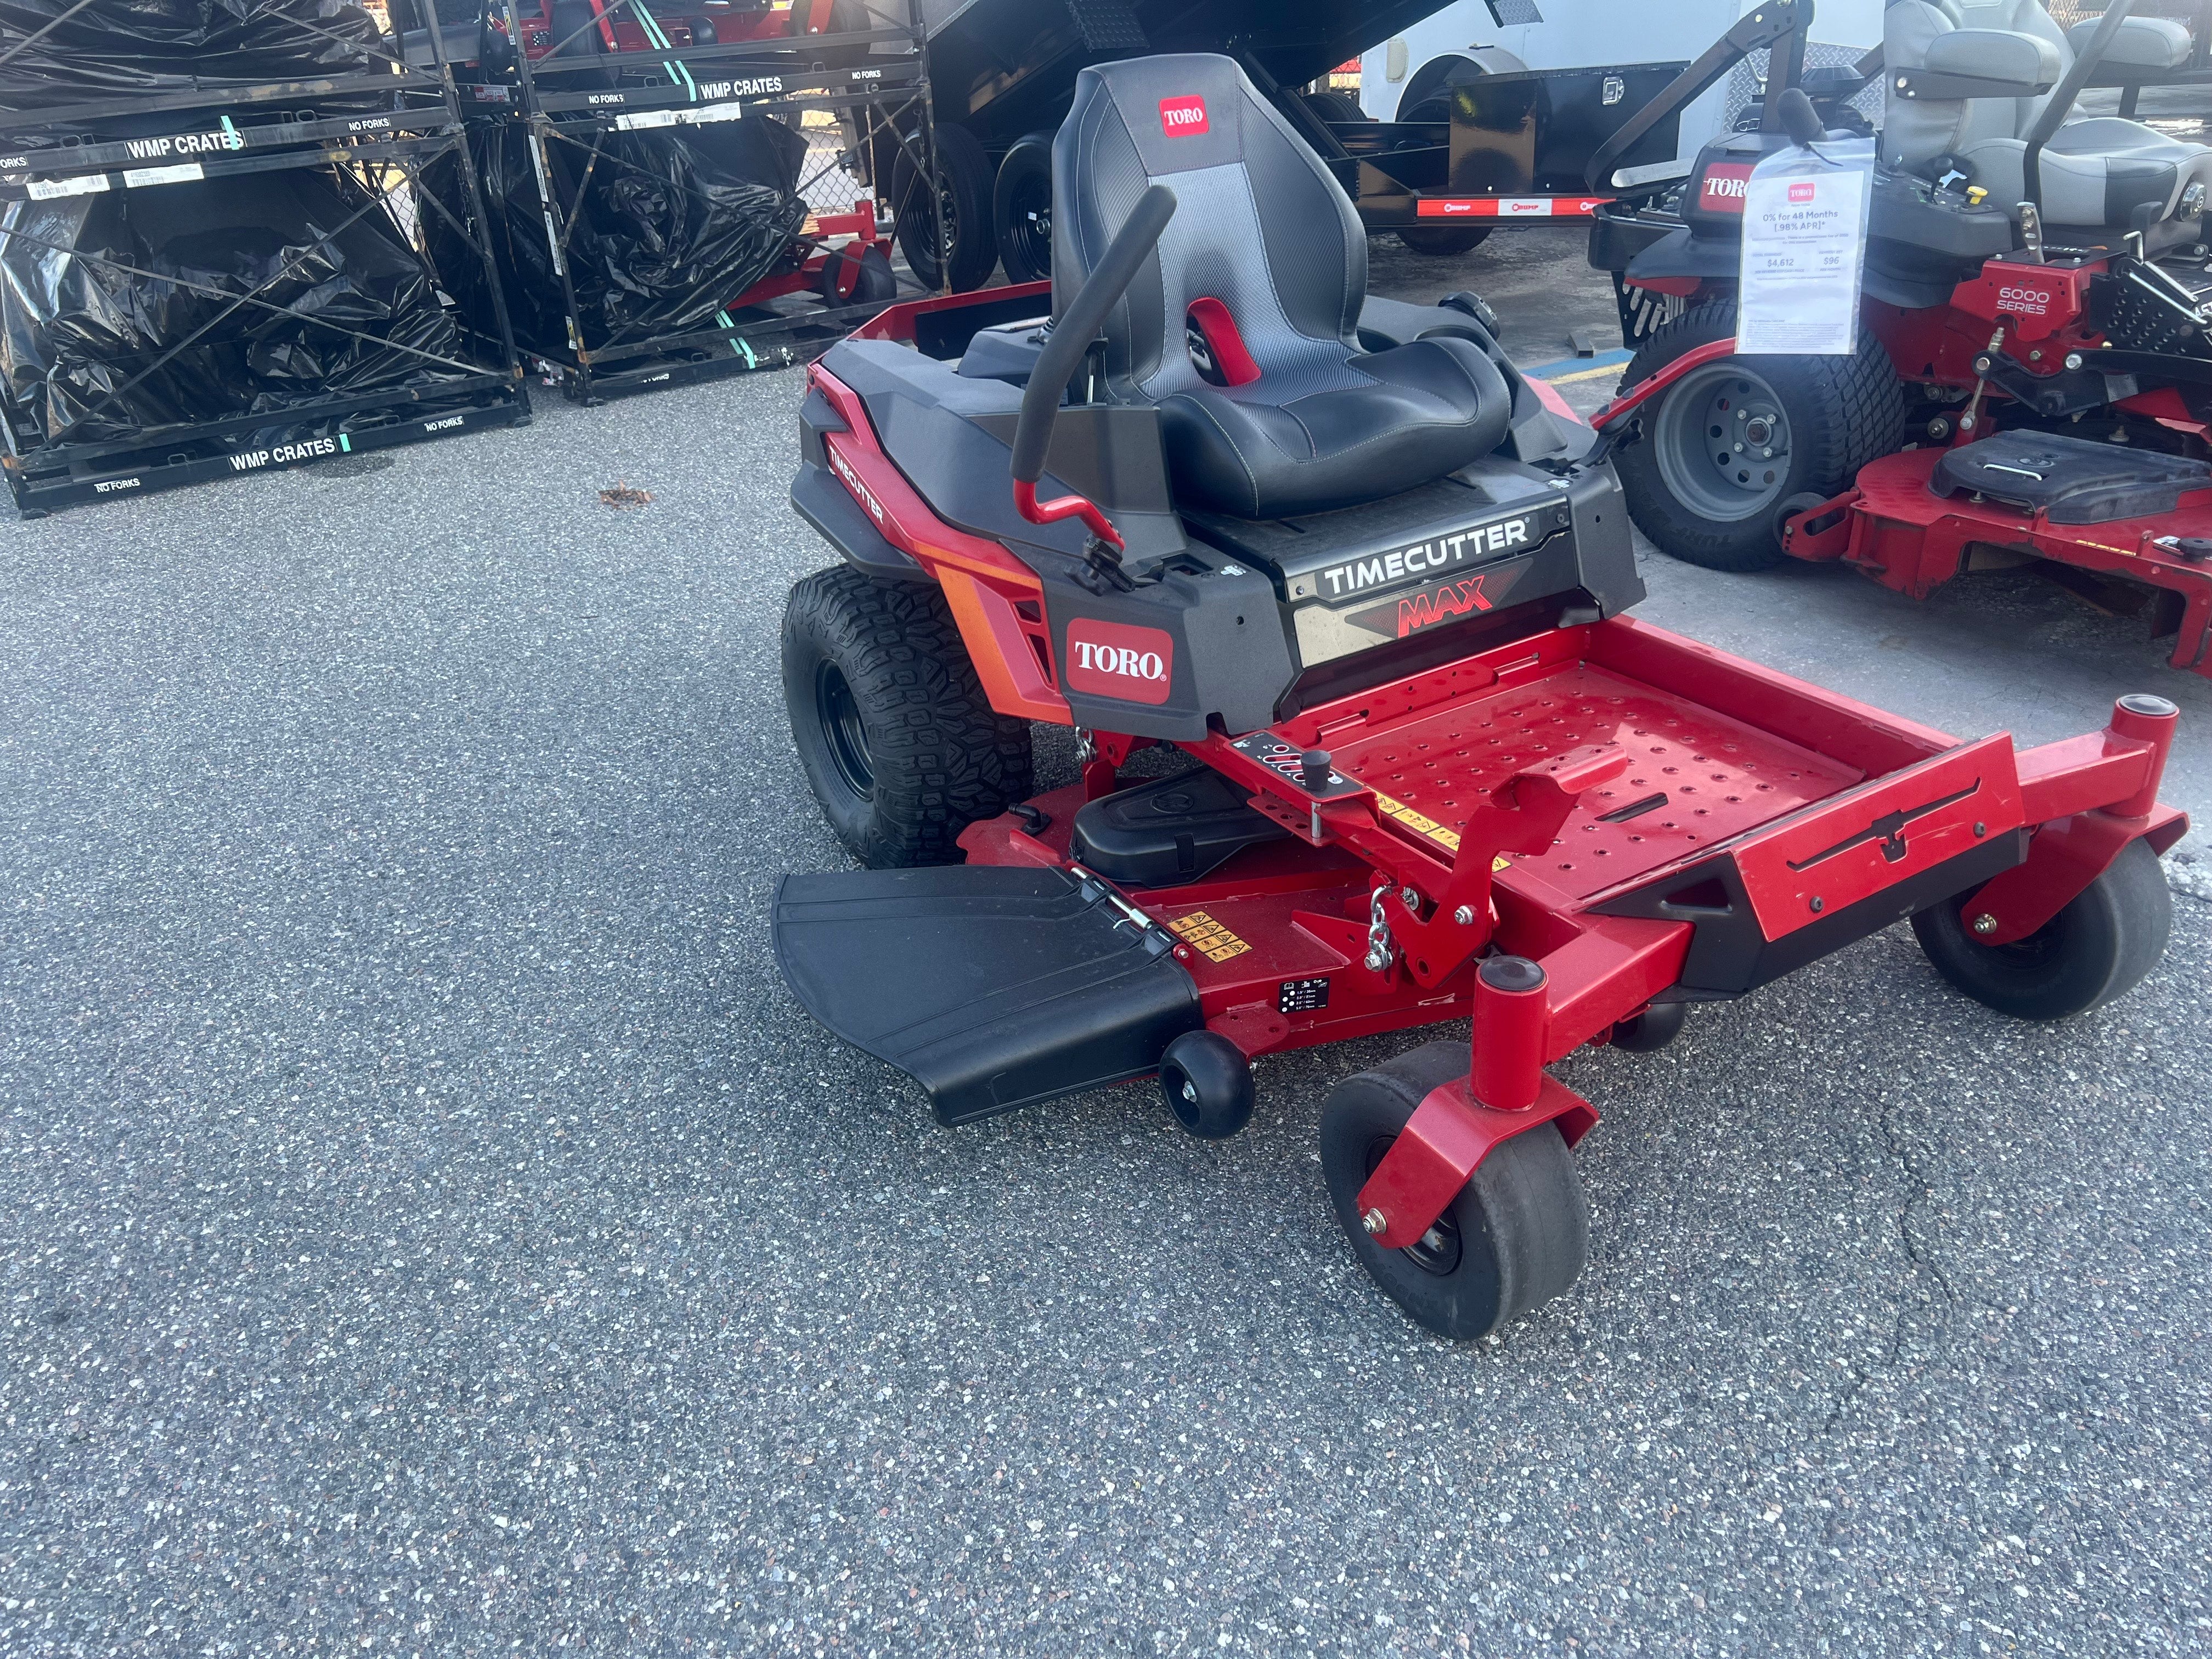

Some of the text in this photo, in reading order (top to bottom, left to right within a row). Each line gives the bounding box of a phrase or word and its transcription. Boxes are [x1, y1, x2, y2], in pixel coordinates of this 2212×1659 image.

[851, 69, 881, 80] NO FORKS
[700, 77, 783, 100] WMP CRATES
[589, 93, 624, 104] NO FORKS
[1164, 107, 1203, 126] TORO
[348, 117, 390, 132] NO FORKS
[127, 131, 245, 159] WMP CRATES
[1706, 178, 1747, 198] TOR
[1790, 189, 1812, 198] TORO
[1763, 213, 1776, 222] 0%
[1806, 210, 1838, 219] Months
[1767, 258, 1794, 268] $4,612
[1824, 257, 1839, 265] $96
[2000, 287, 2050, 303] 6000
[1997, 300, 2046, 315] SERIES
[425, 417, 463, 432] NO FORKS
[230, 438, 335, 471] WMP CRATES
[95, 477, 140, 493] NO FORKS
[829, 444, 883, 524] TIMECUTTER
[1397, 575, 1493, 639] MAX
